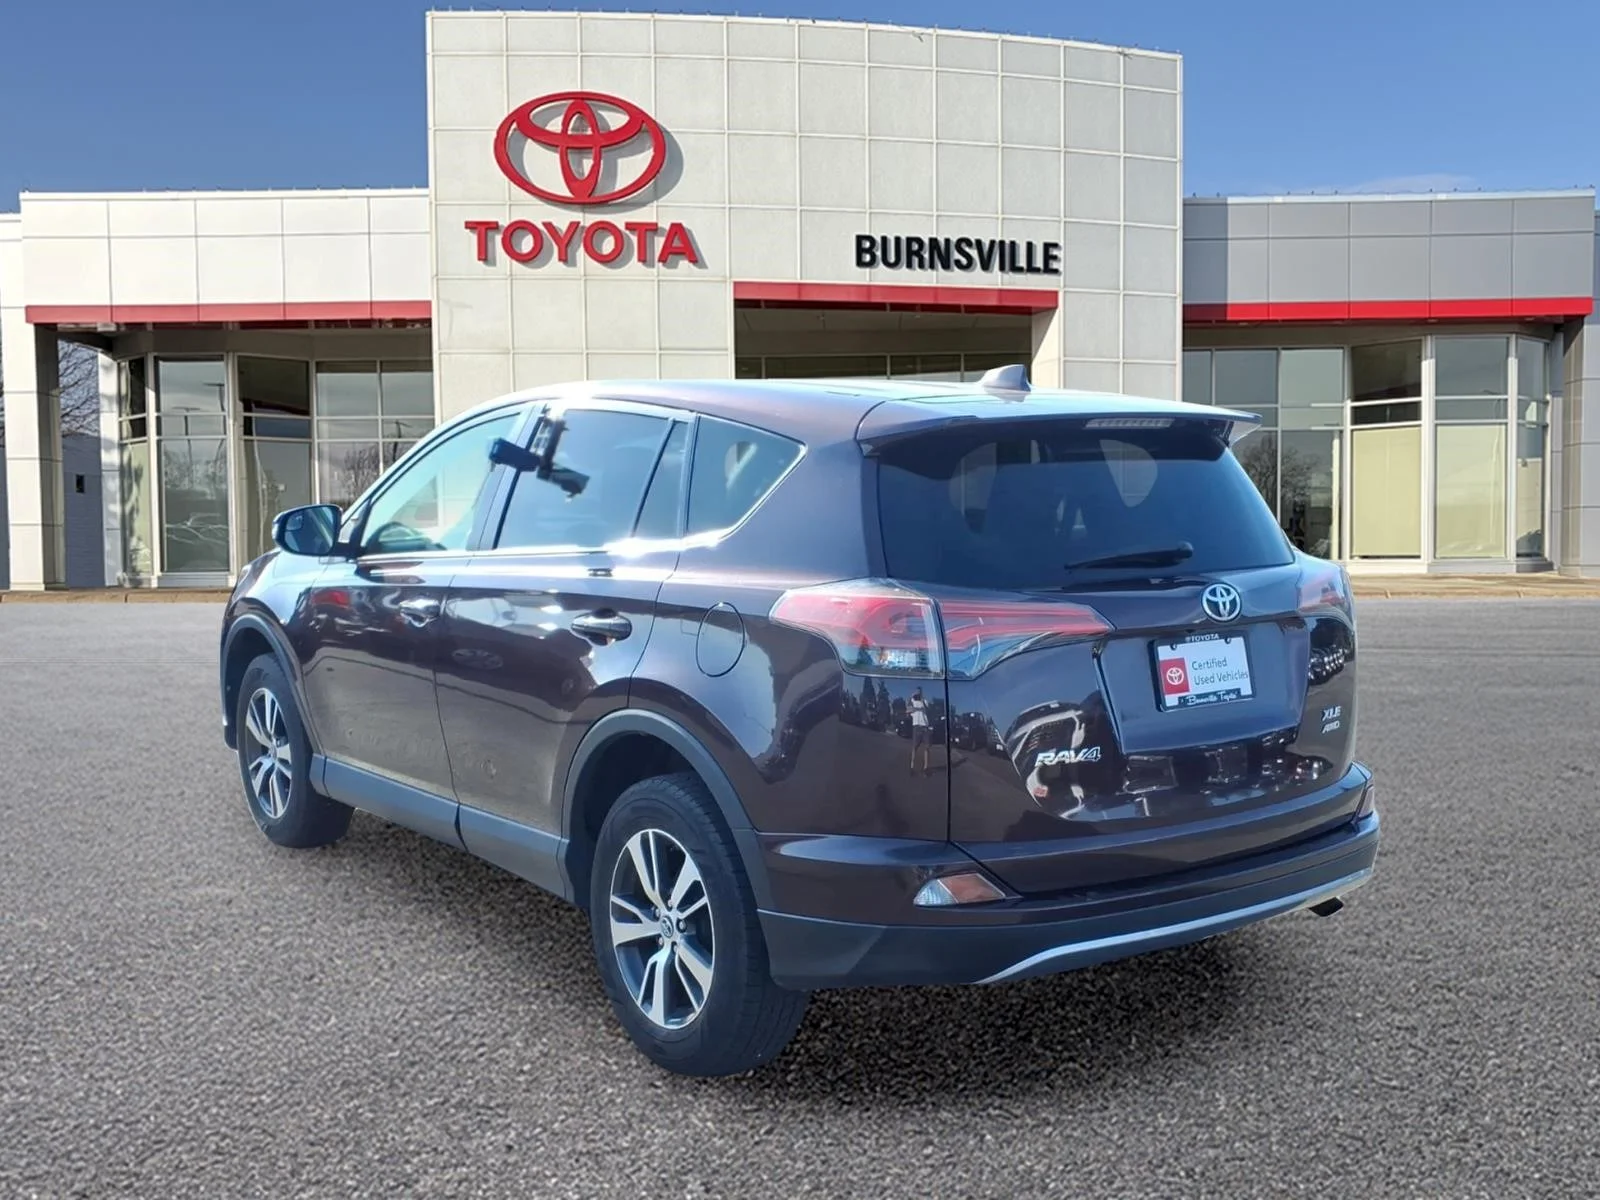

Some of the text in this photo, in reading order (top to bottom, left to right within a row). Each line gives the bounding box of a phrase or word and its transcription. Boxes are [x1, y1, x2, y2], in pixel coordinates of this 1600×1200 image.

[465, 220, 699, 267] TOYOTA
[855, 234, 1061, 273] BURNSVILLE
[1191, 633, 1219, 642] TOYOTA
[1191, 658, 1228, 671] Certified
[1194, 674, 1215, 686] Used
[1322, 705, 1341, 721] XLE
[1034, 746, 1101, 767] RAV4
